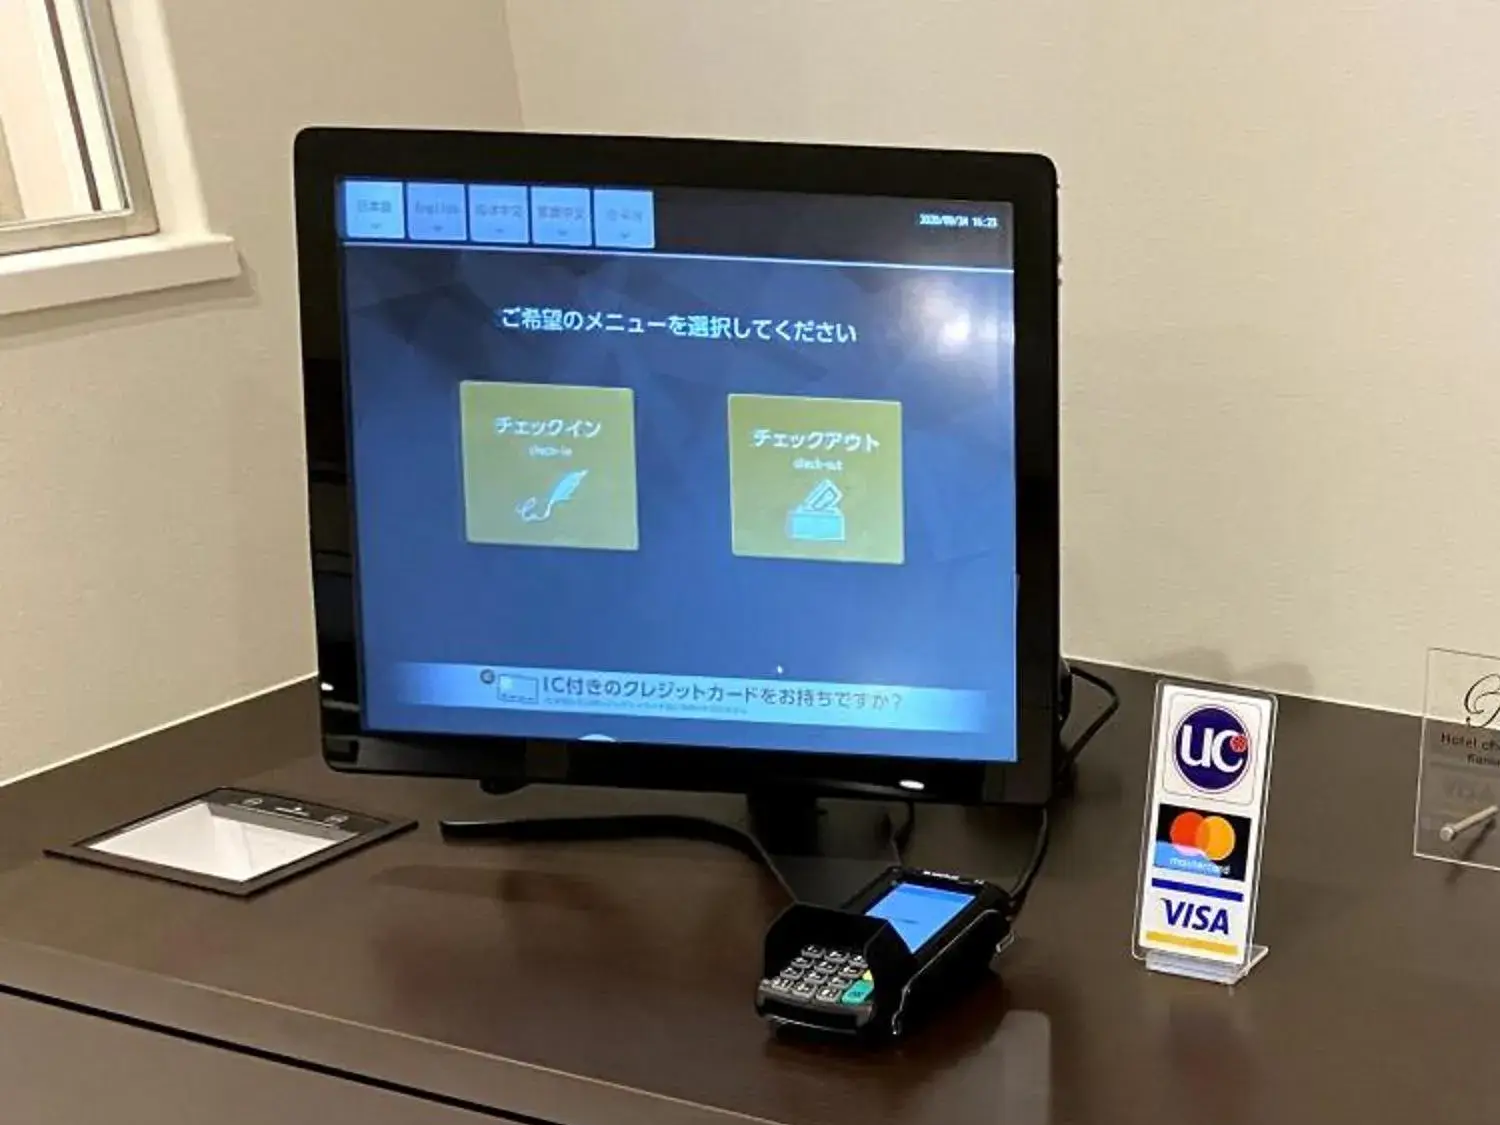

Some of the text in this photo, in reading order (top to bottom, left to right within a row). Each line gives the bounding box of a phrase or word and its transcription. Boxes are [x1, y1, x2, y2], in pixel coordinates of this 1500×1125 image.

[502, 307, 857, 342] ご希望のメニューを選択してください
[495, 417, 600, 438] チェックイン
[752, 429, 880, 452] チェックアウト
[1180, 724, 1244, 773] UC
[1441, 731, 1477, 749] Hotel
[1169, 857, 1231, 875] mastercard
[1160, 898, 1229, 935] VISA
